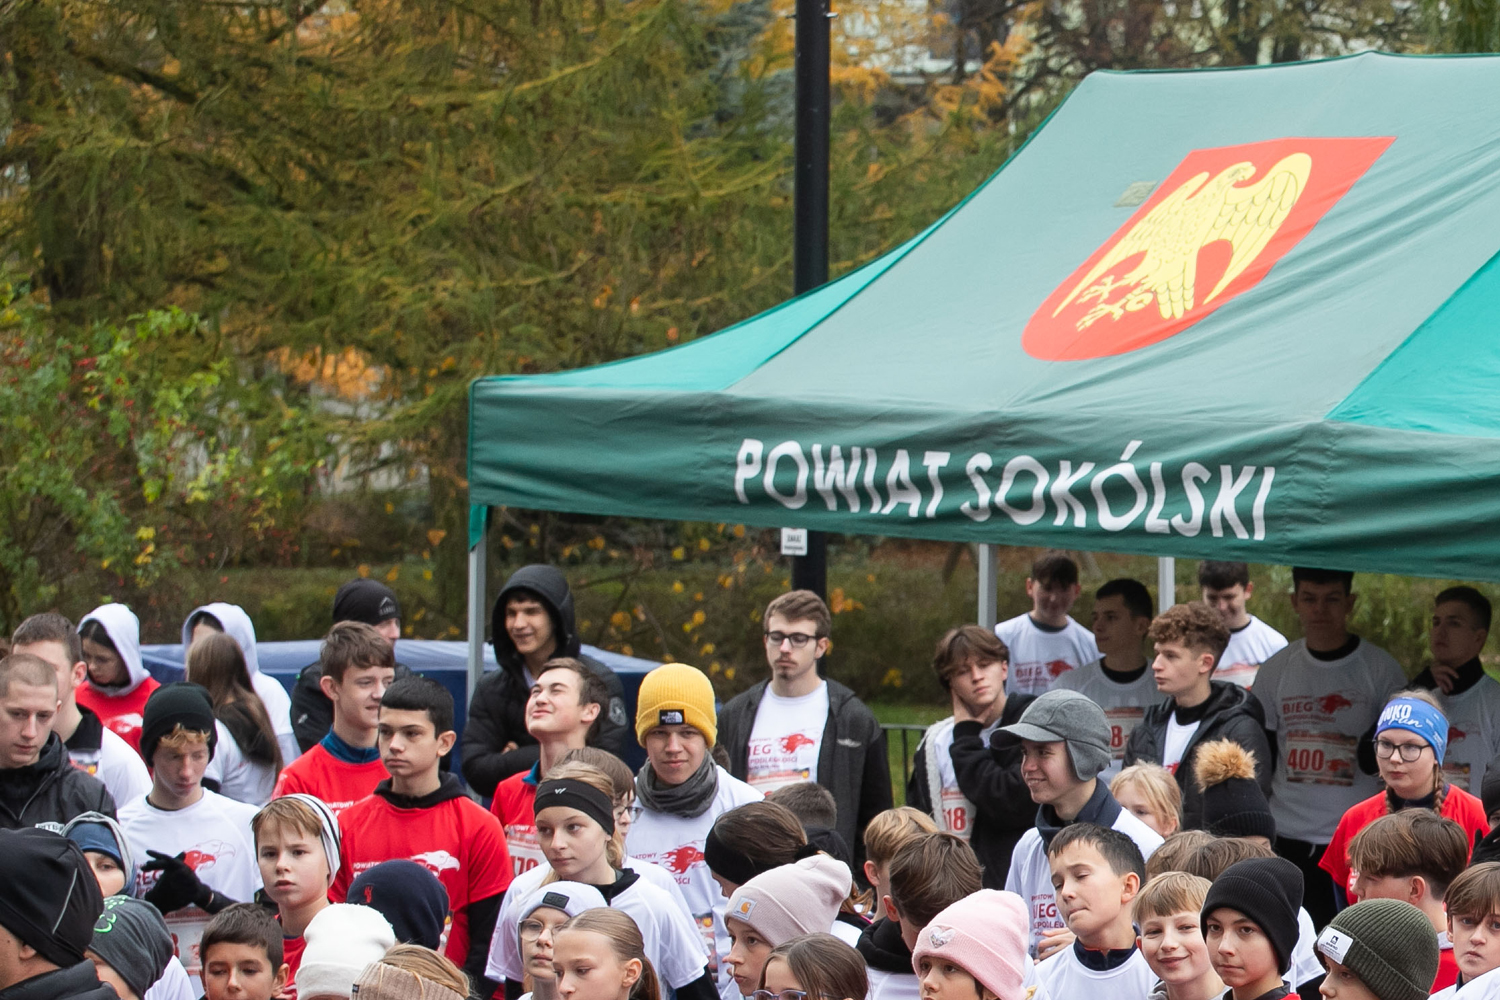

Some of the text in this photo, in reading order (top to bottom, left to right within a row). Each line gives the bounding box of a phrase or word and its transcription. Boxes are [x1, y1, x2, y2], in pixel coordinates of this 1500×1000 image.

[734, 438, 1276, 541] POWIAT SOKÓLSKI
[1283, 702, 1314, 714] BIEG
[1288, 748, 1324, 772] 400
